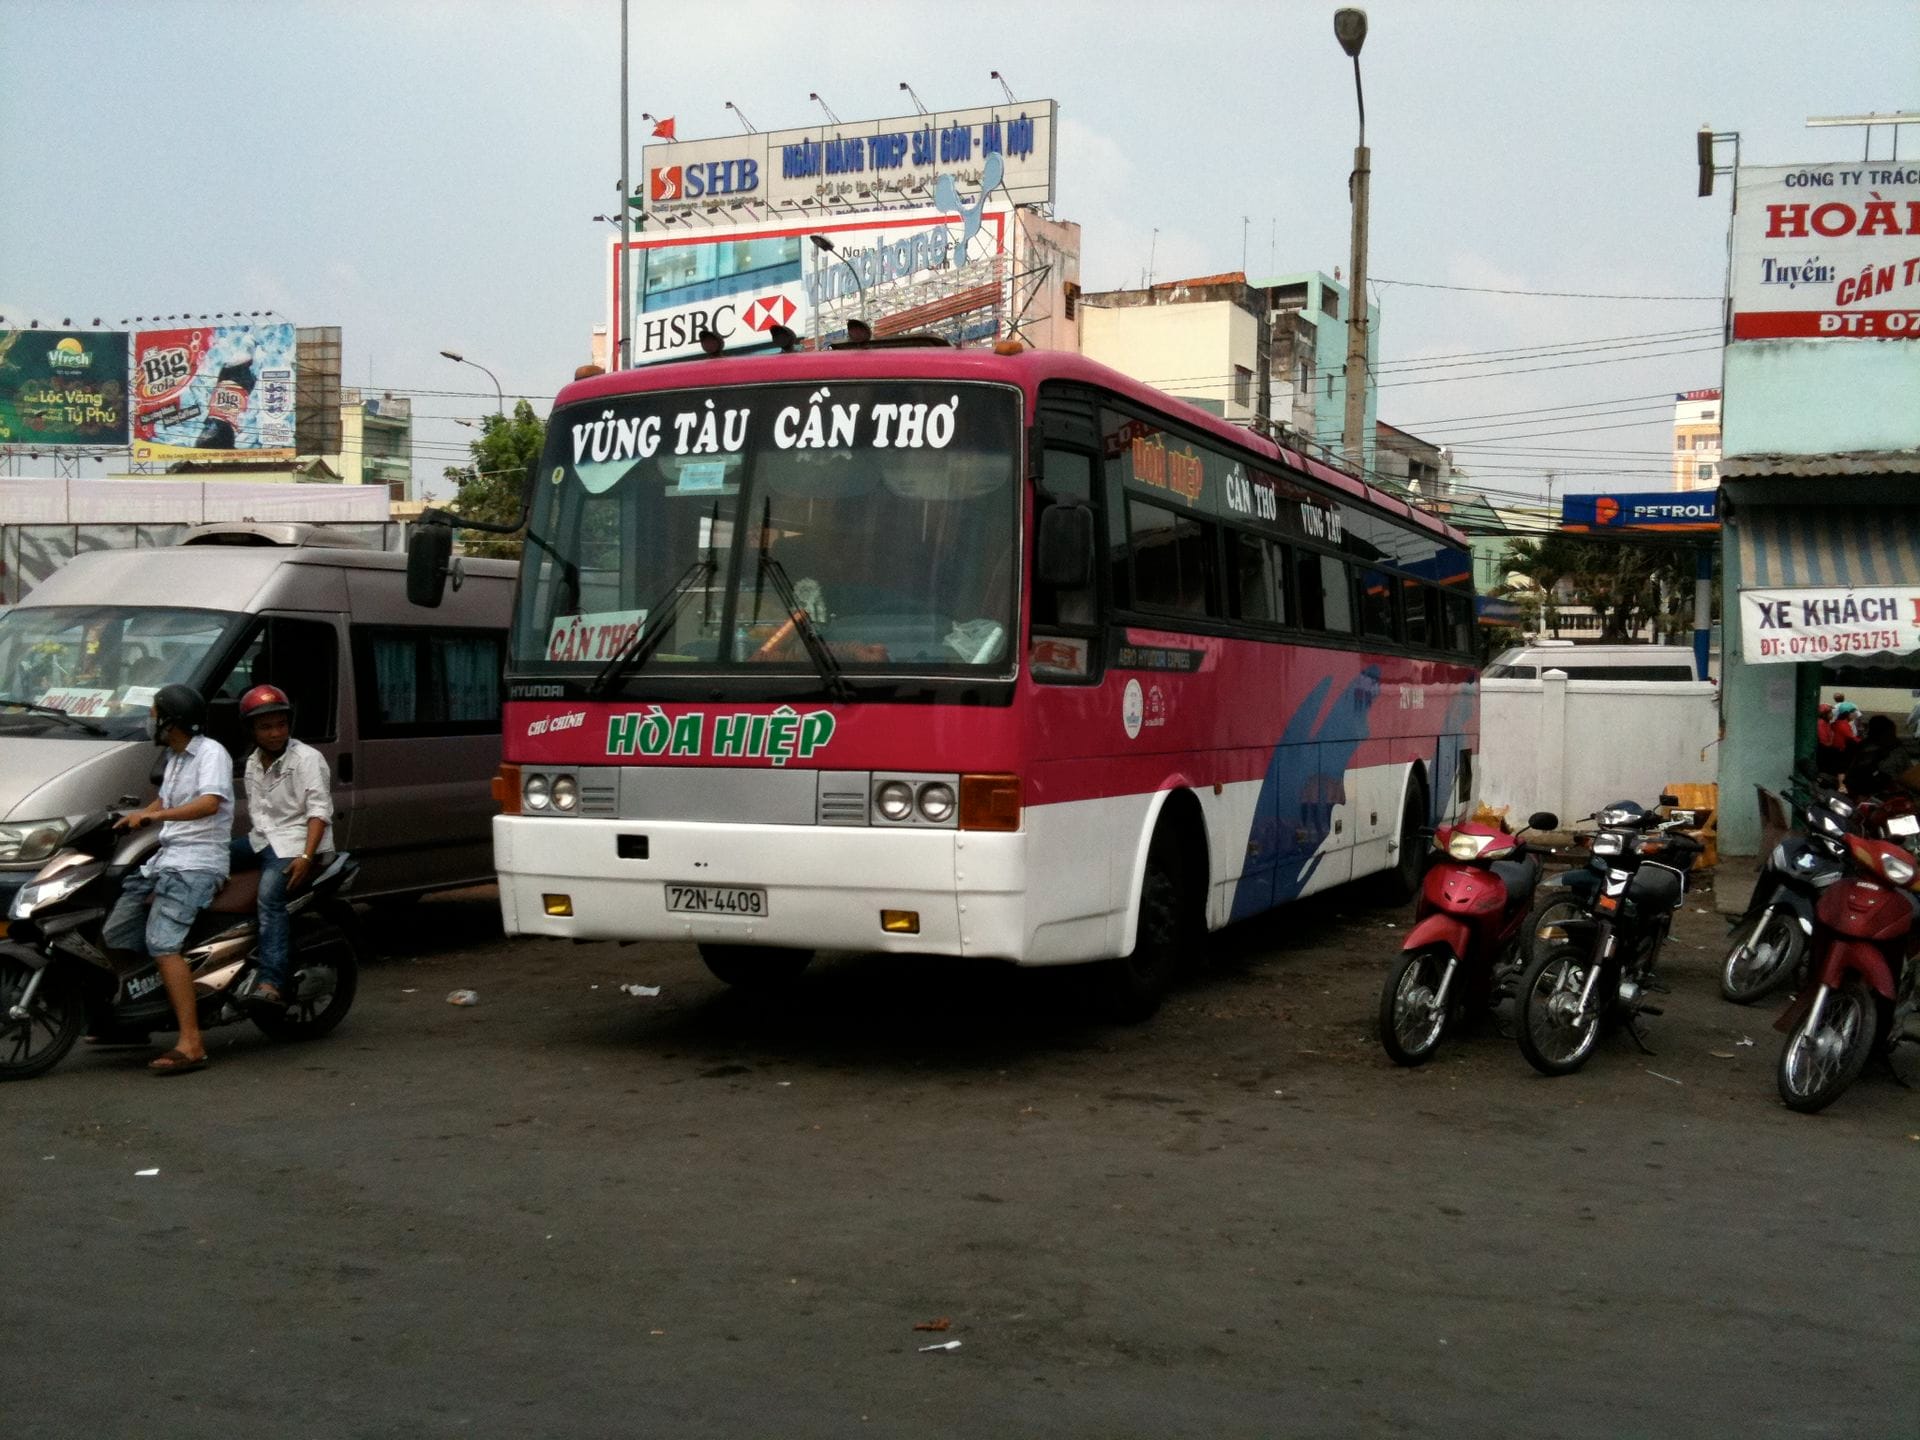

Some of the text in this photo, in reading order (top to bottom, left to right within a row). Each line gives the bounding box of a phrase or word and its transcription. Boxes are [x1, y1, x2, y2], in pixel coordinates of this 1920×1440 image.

[782, 136, 821, 179] NGÂN
[825, 132, 864, 174] HÀNG
[868, 131, 908, 172] TMCP
[912, 122, 937, 166] SÀI
[940, 119, 972, 164] GÒN
[1007, 111, 1034, 162] NỘI
[684, 158, 760, 199] SHB
[1785, 169, 1834, 188] CÔNG
[1840, 171, 1863, 186] TY
[1761, 256, 1920, 306] Tuyến: CẦN T
[641, 303, 737, 354] HSBC
[1819, 314, 1874, 332] ĐT:
[144, 350, 189, 385] Big
[150, 378, 176, 395] cola
[571, 400, 751, 465] VŨNG TÀU
[774, 386, 959, 449] CẦN THƠ
[1226, 462, 1277, 521] CẦN THƠ
[1758, 600, 1793, 630] XE
[1802, 594, 1899, 627] KHÁCH
[550, 616, 595, 663] CẦN
[1760, 629, 1901, 656] ĐT: 0710.3751751
[511, 685, 565, 697] HYUNDAI
[605, 704, 836, 766] HÒA HIỆP
[671, 888, 762, 914] 72N-4409
